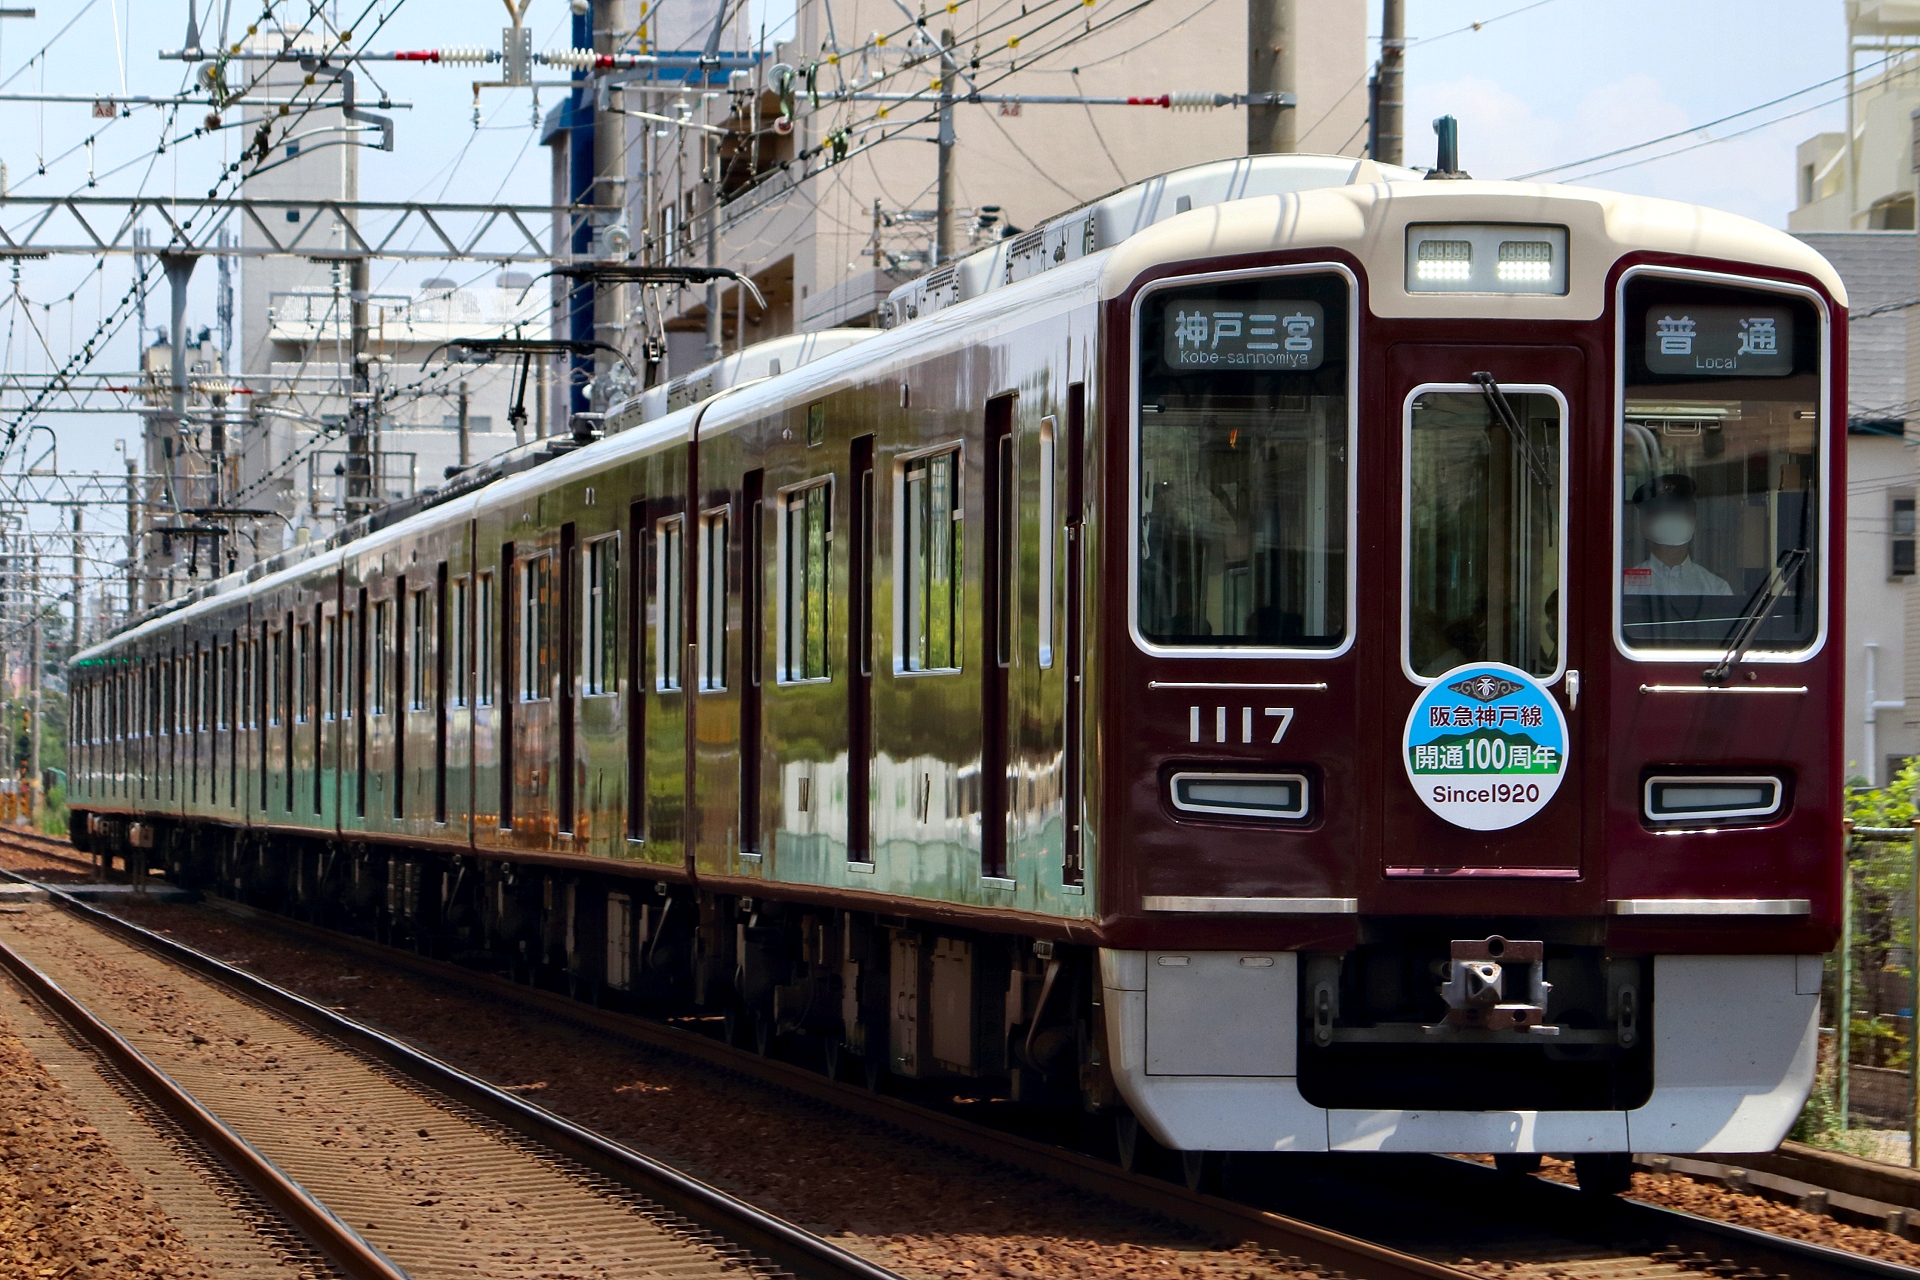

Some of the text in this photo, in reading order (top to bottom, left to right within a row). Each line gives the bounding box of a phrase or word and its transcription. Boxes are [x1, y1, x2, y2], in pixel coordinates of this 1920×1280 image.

[1174, 310, 1315, 351] 神戸三宮
[1655, 315, 1778, 356] 普通
[1180, 350, 1309, 367] Kobe-sannomiya
[1695, 355, 1738, 369] Local
[1189, 706, 1295, 744] 1117
[1429, 705, 1543, 727] 阪急神戸線
[1415, 738, 1557, 770] 開通100周年
[1432, 783, 1540, 803] Since1920
